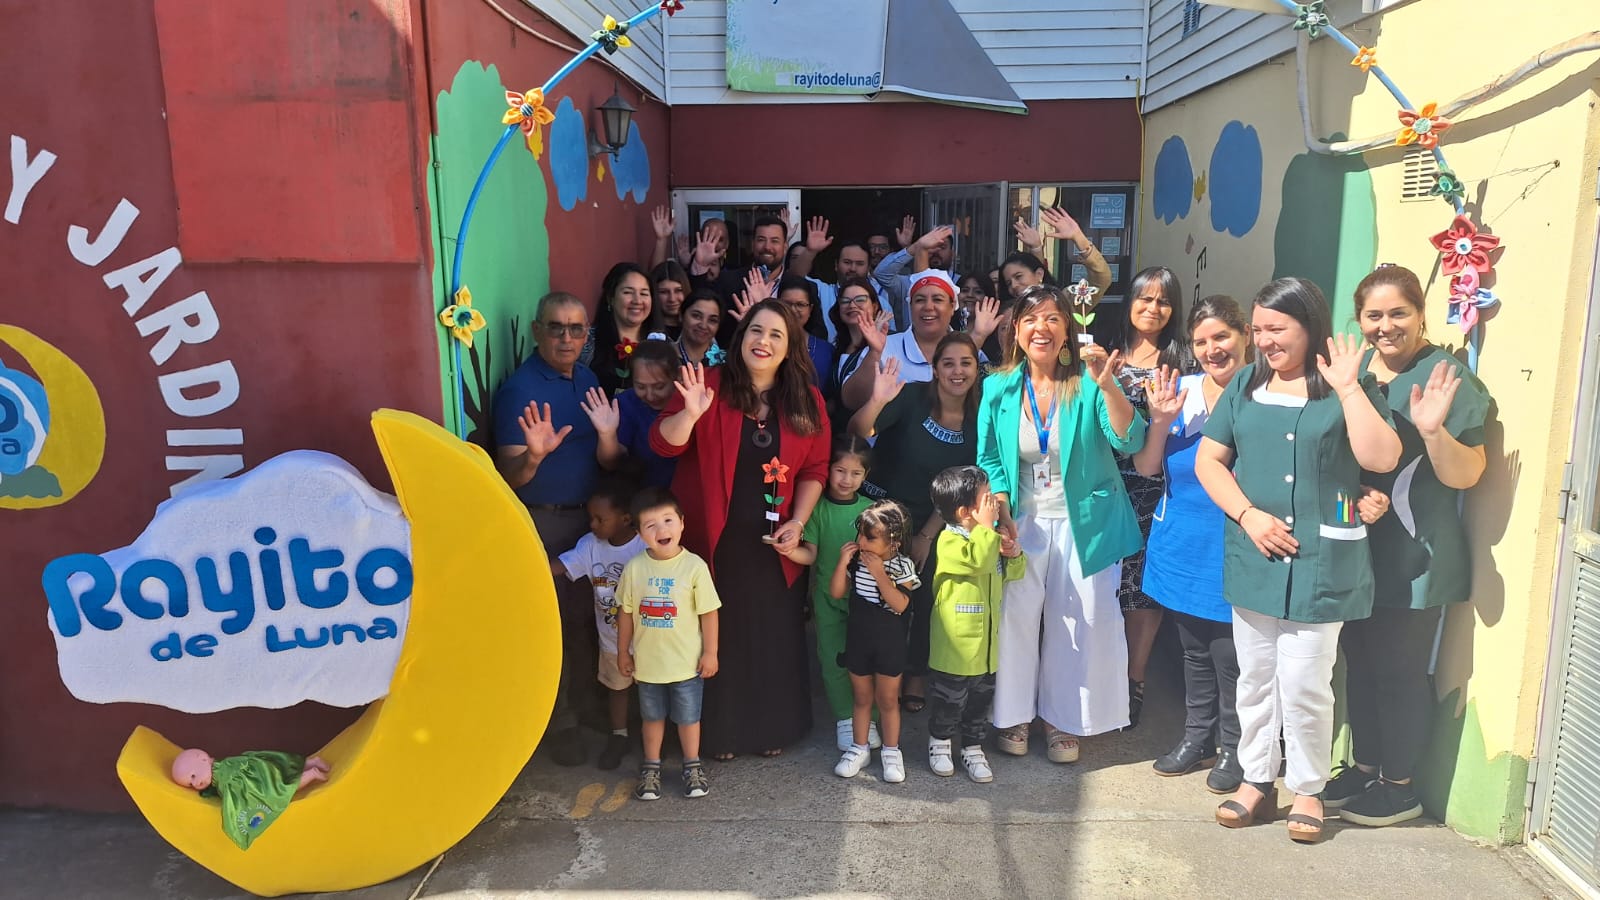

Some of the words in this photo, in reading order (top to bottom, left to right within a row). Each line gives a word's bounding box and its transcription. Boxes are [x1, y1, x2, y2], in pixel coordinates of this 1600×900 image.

[793, 72, 881, 88] rayitodeluna@
[4, 134, 57, 224] Y
[41, 526, 414, 637] Rayito
[150, 632, 218, 661] de
[265, 617, 397, 652] Luna
